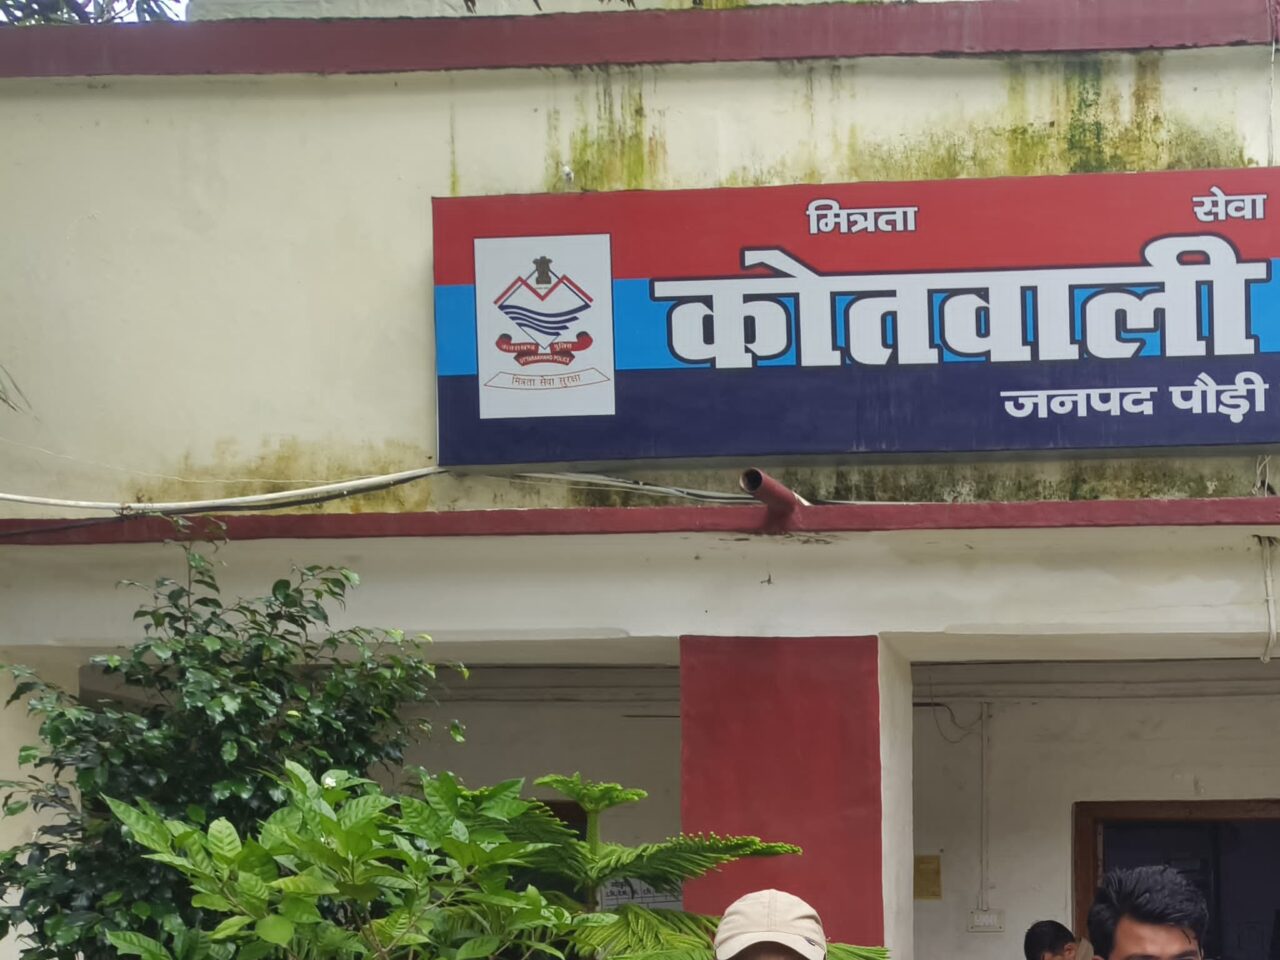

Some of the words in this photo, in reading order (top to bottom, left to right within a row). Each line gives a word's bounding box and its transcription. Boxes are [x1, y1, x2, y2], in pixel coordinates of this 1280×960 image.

[805, 198, 918, 235] मित्रता
[1192, 186, 1268, 222] सेवा
[652, 235, 1268, 368] कोतवाली
[1000, 386, 1159, 419] जनपद
[1169, 371, 1270, 423] पौड़ी
